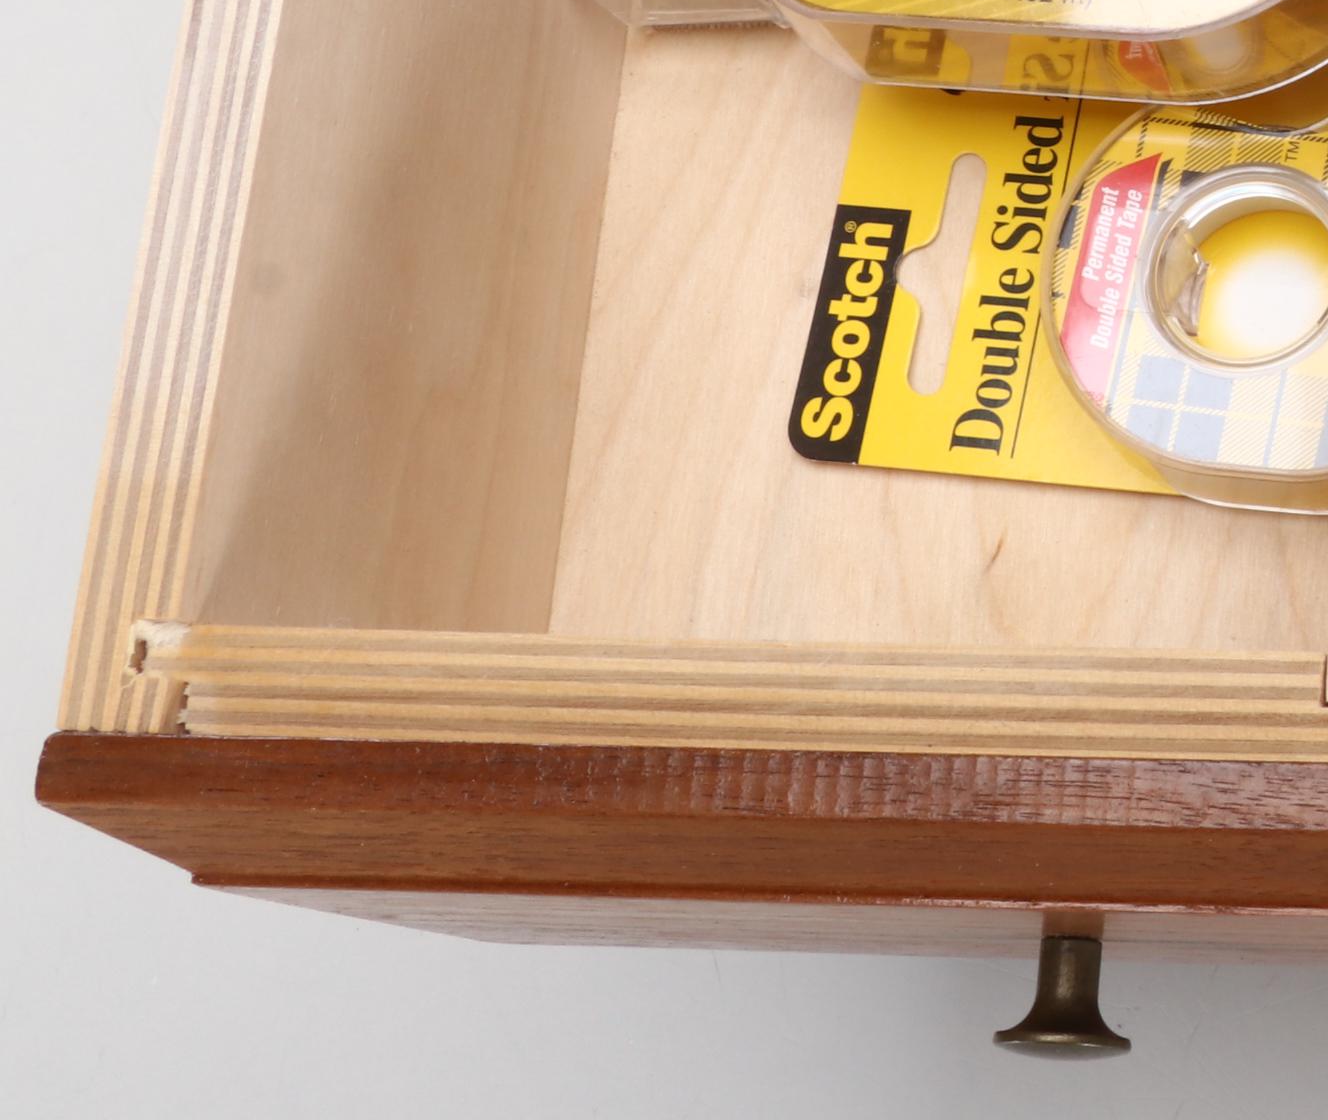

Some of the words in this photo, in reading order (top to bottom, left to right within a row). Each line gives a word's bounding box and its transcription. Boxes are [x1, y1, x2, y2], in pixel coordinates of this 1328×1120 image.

[991, 115, 1064, 255] Sided
[1117, 188, 1143, 229] Tape
[1082, 187, 1119, 281] Permanent
[1105, 234, 1131, 284] Sided
[1090, 290, 1120, 349] Double
[949, 267, 1035, 456] Double
